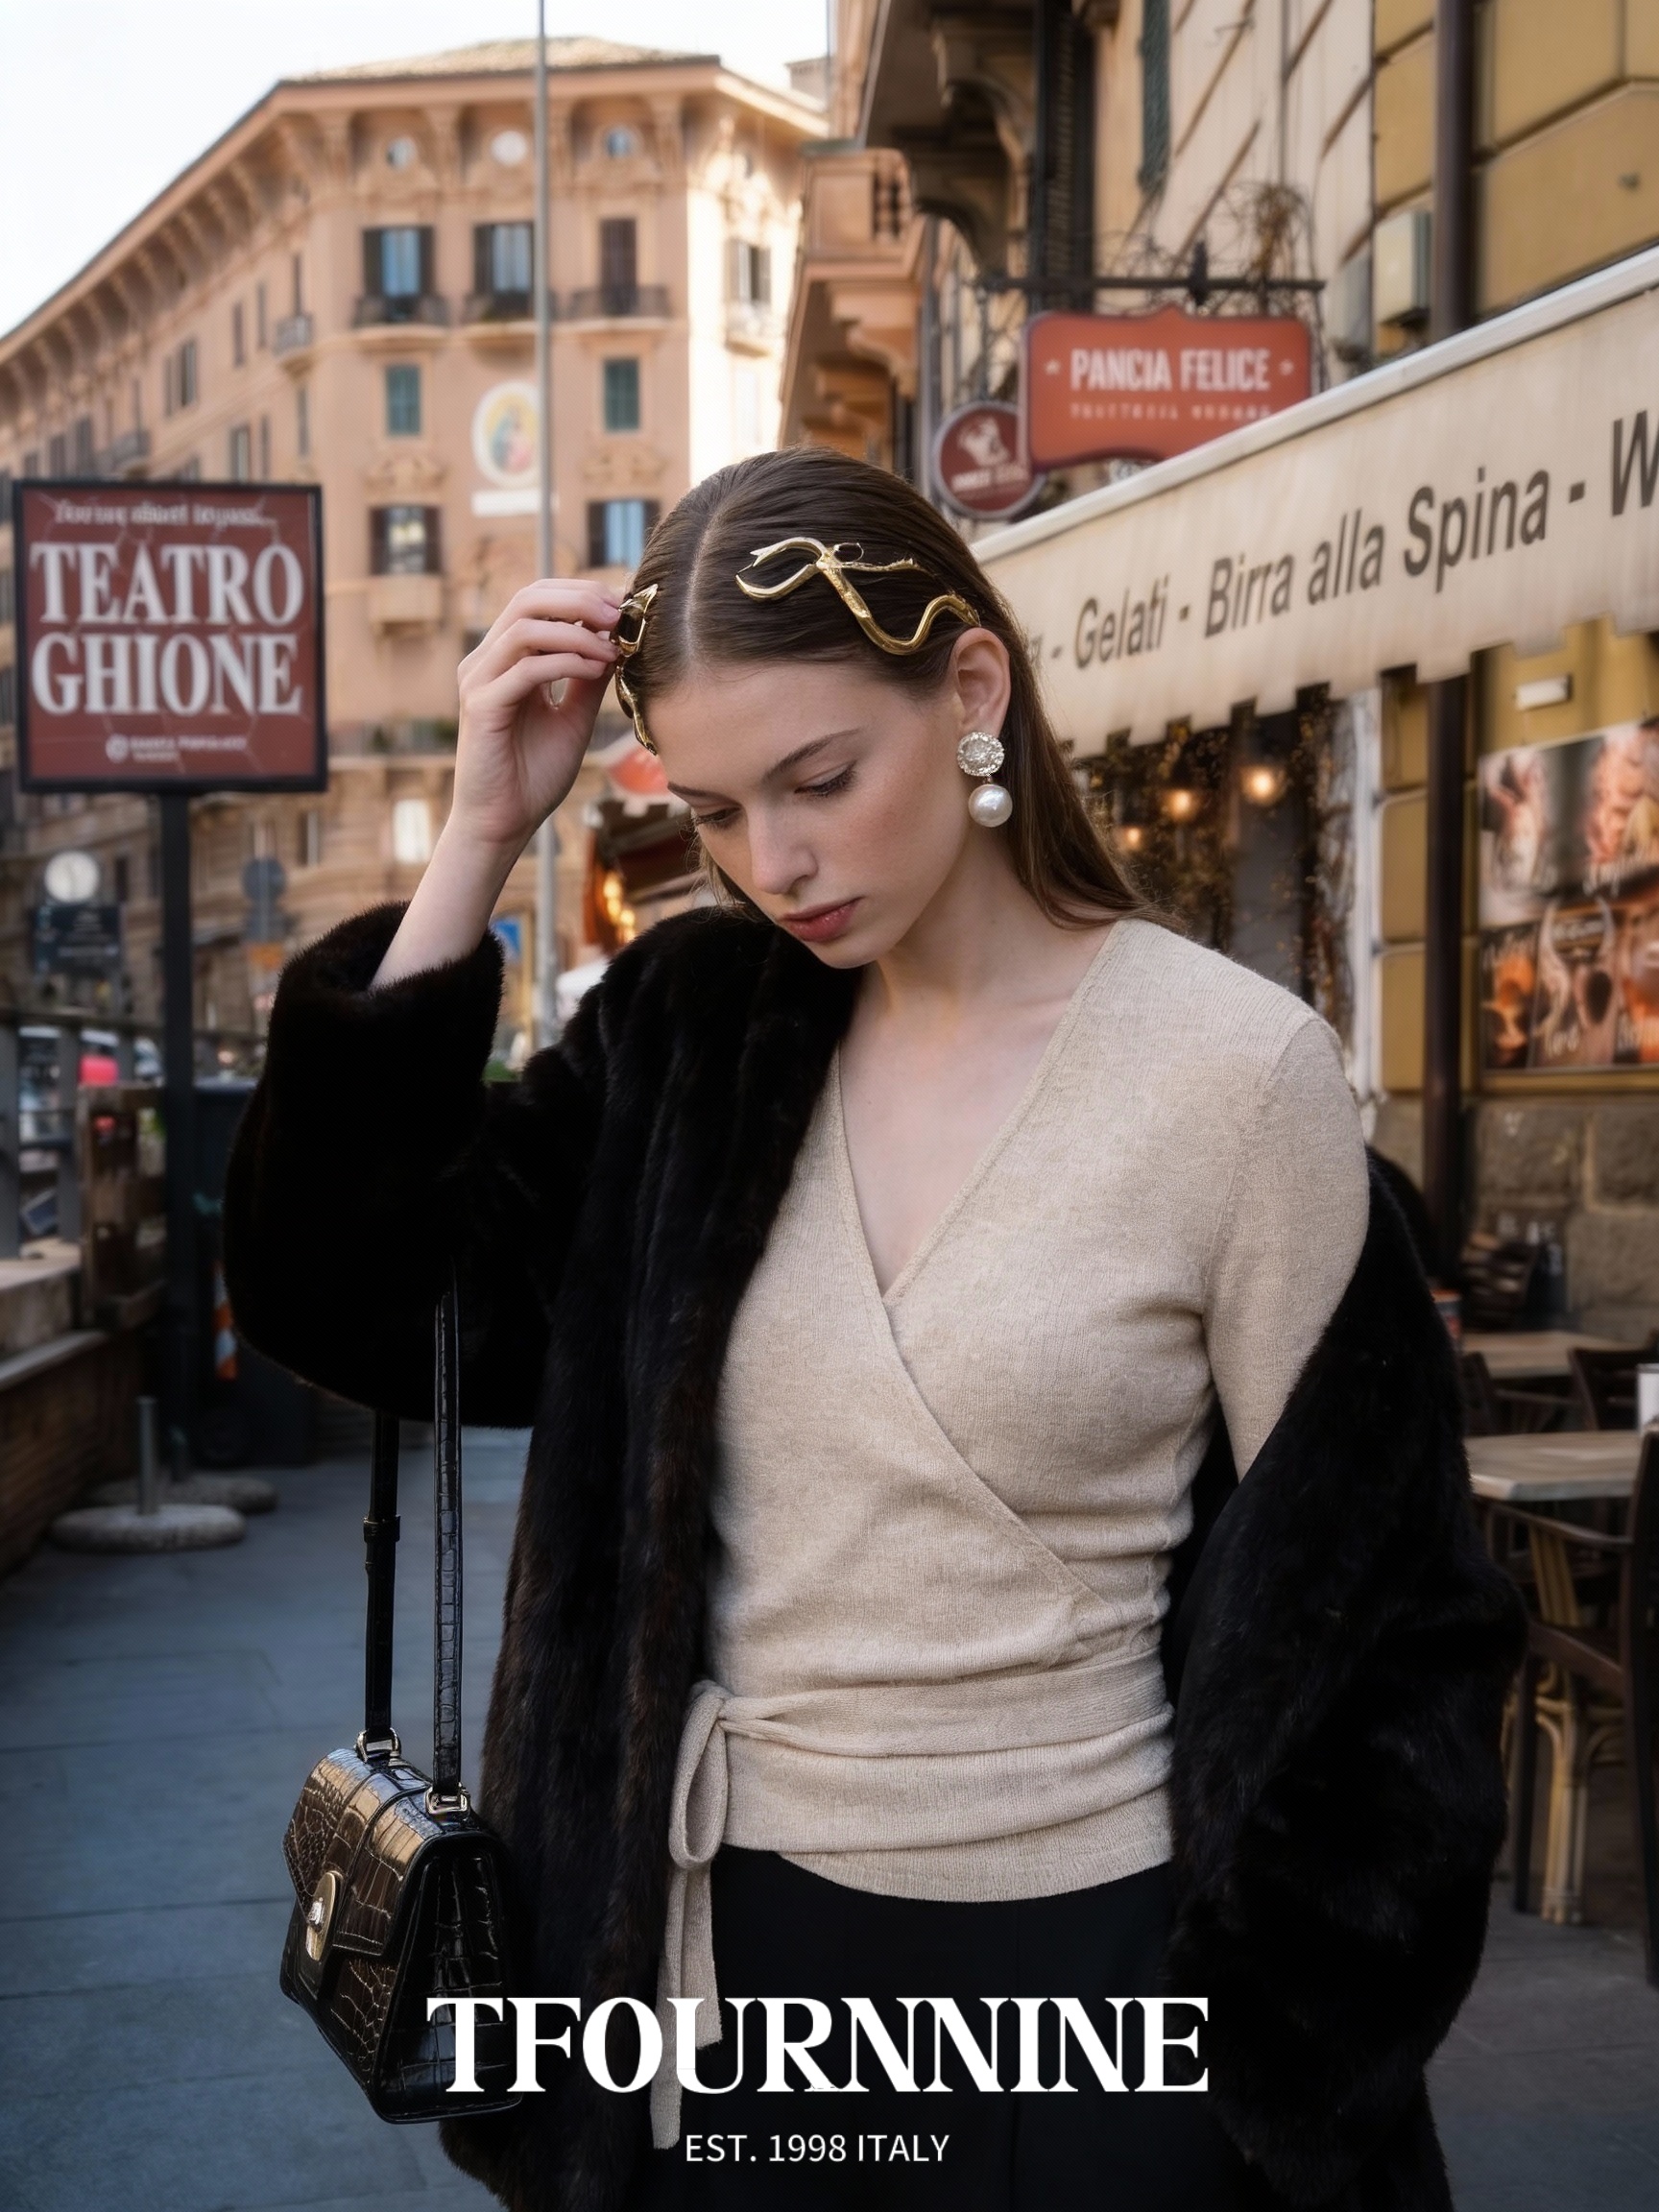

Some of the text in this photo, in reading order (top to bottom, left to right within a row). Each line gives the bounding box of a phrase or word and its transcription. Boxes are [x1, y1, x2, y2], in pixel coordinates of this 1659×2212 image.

[1070, 348, 1271, 392] PANCIA FELICE
[30, 542, 303, 626] TEATRO
[1075, 573, 1169, 669] Gelati
[1205, 552, 1294, 638] Birra
[1308, 507, 1384, 606] alla
[1404, 466, 1549, 593] Spina
[32, 632, 301, 716] GHIONE
